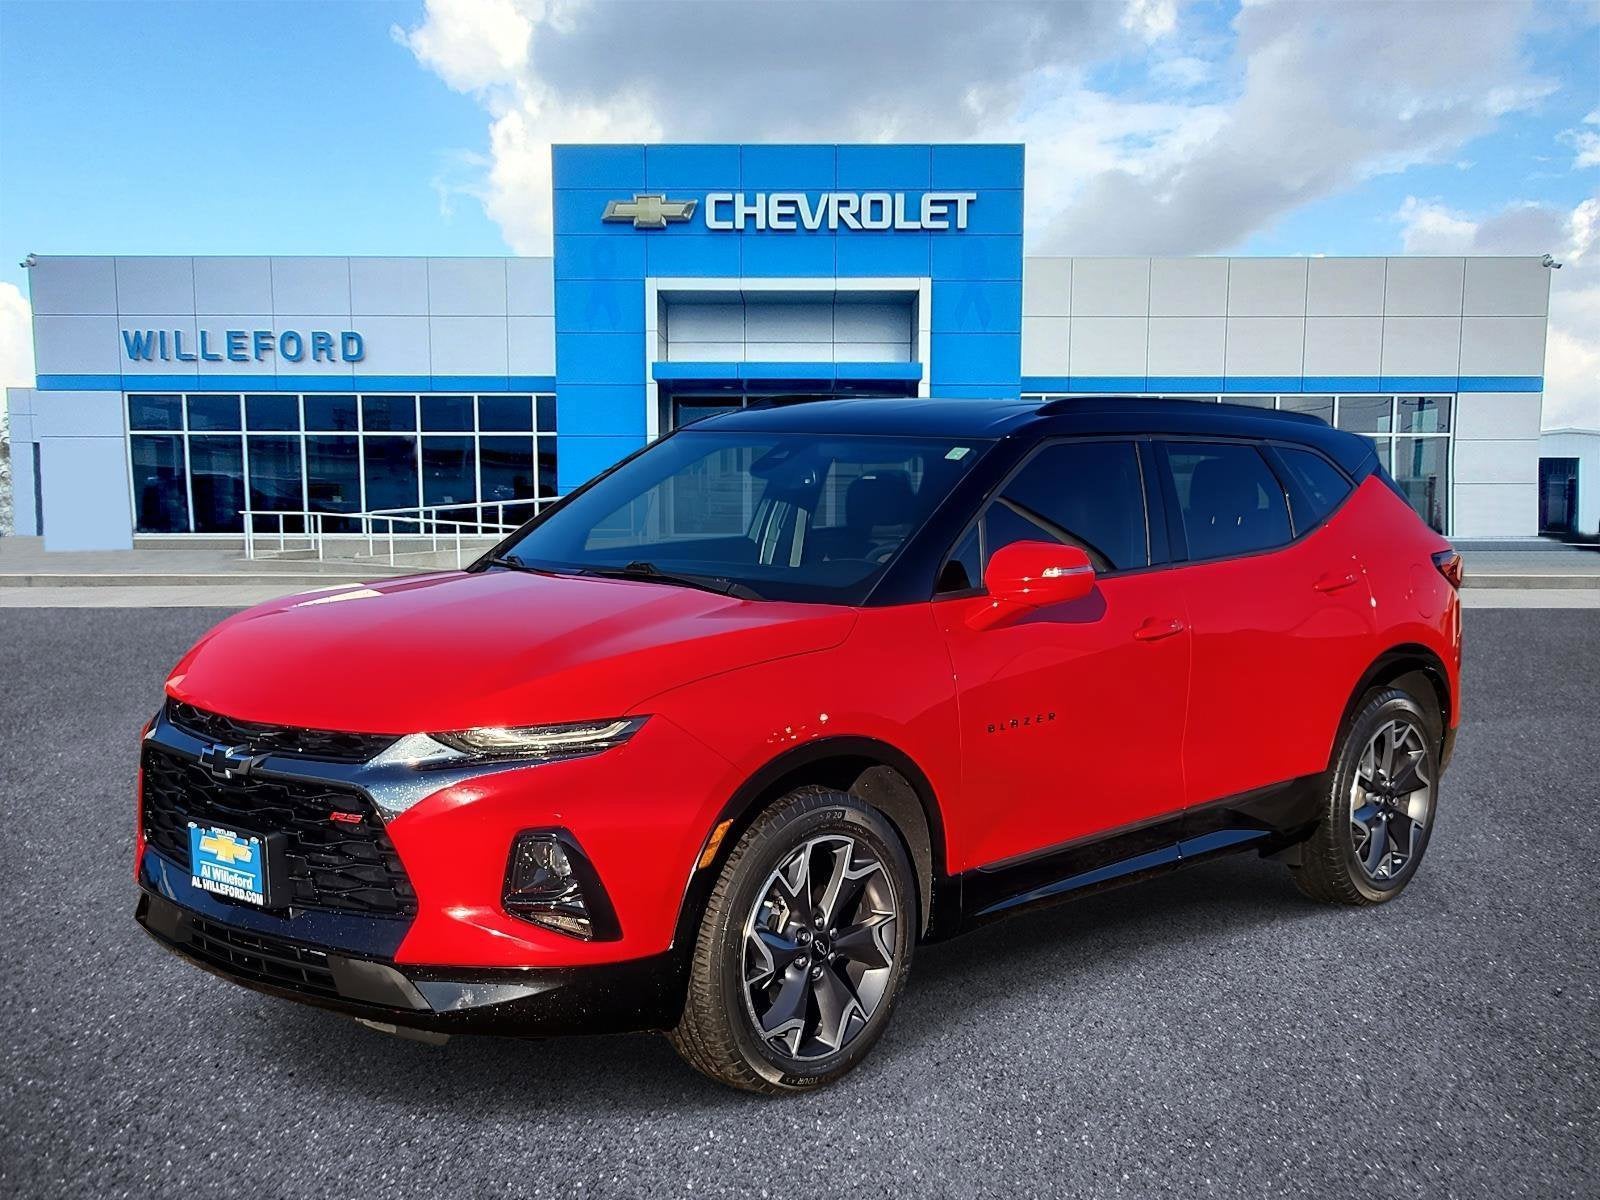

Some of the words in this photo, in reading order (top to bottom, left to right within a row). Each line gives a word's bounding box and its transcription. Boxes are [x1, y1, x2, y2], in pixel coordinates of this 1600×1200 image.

[705, 193, 977, 230] CHEVROLET
[122, 330, 366, 362] WILLEFORD
[987, 711, 1056, 733] BLAZER
[330, 811, 363, 823] RS
[201, 864, 212, 878] Al
[211, 866, 253, 889] Willeford
